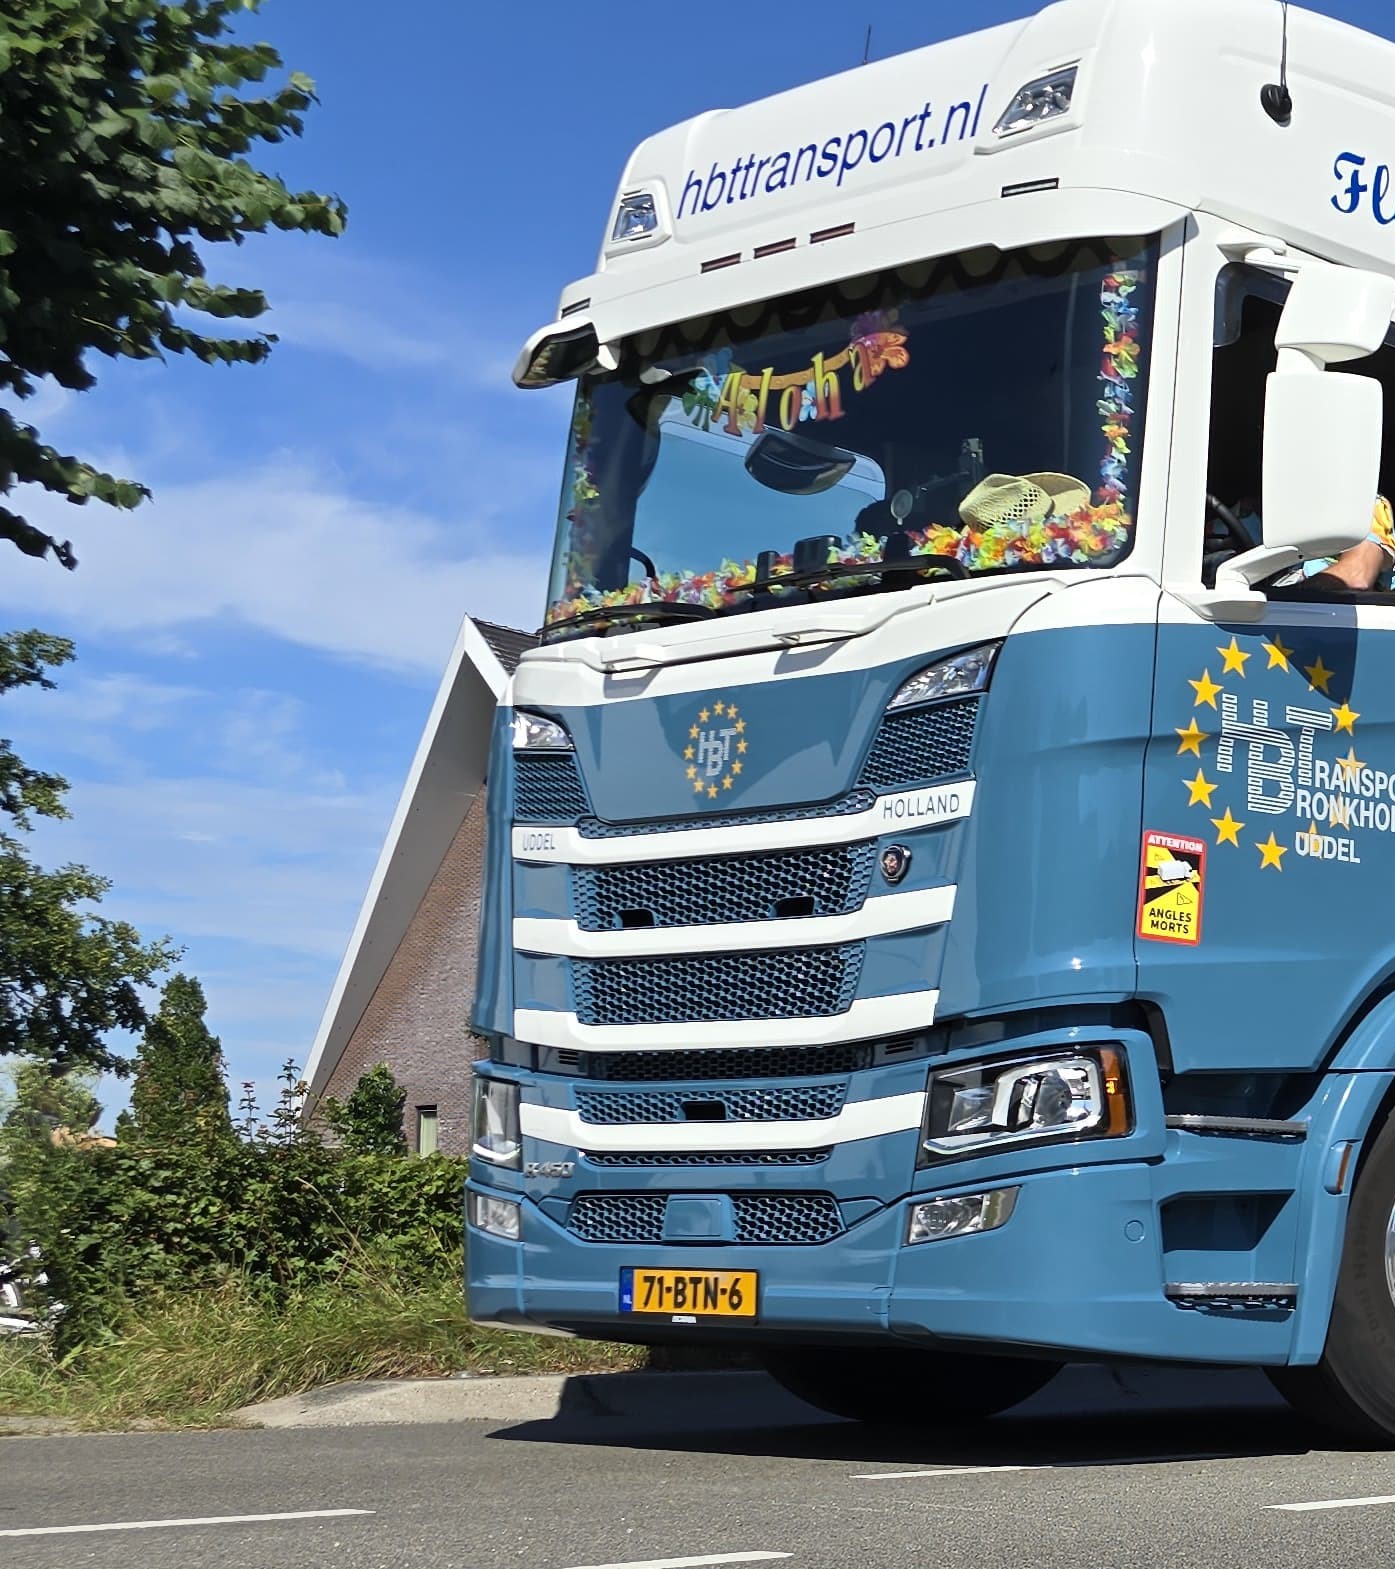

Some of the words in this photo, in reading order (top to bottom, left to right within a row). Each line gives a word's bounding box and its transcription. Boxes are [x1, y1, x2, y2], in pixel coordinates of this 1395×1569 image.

[676, 83, 989, 220] hbttransport.nl
[710, 341, 878, 437] Aloha
[883, 793, 960, 820] HOLLAND
[523, 832, 556, 851] UDDEL
[1148, 834, 1204, 853] ATTENTION
[1295, 831, 1361, 864] UDDEL
[1149, 907, 1192, 923] ANGLES
[1150, 919, 1189, 935] MORTS
[642, 1275, 744, 1312] 71-BTN-6
